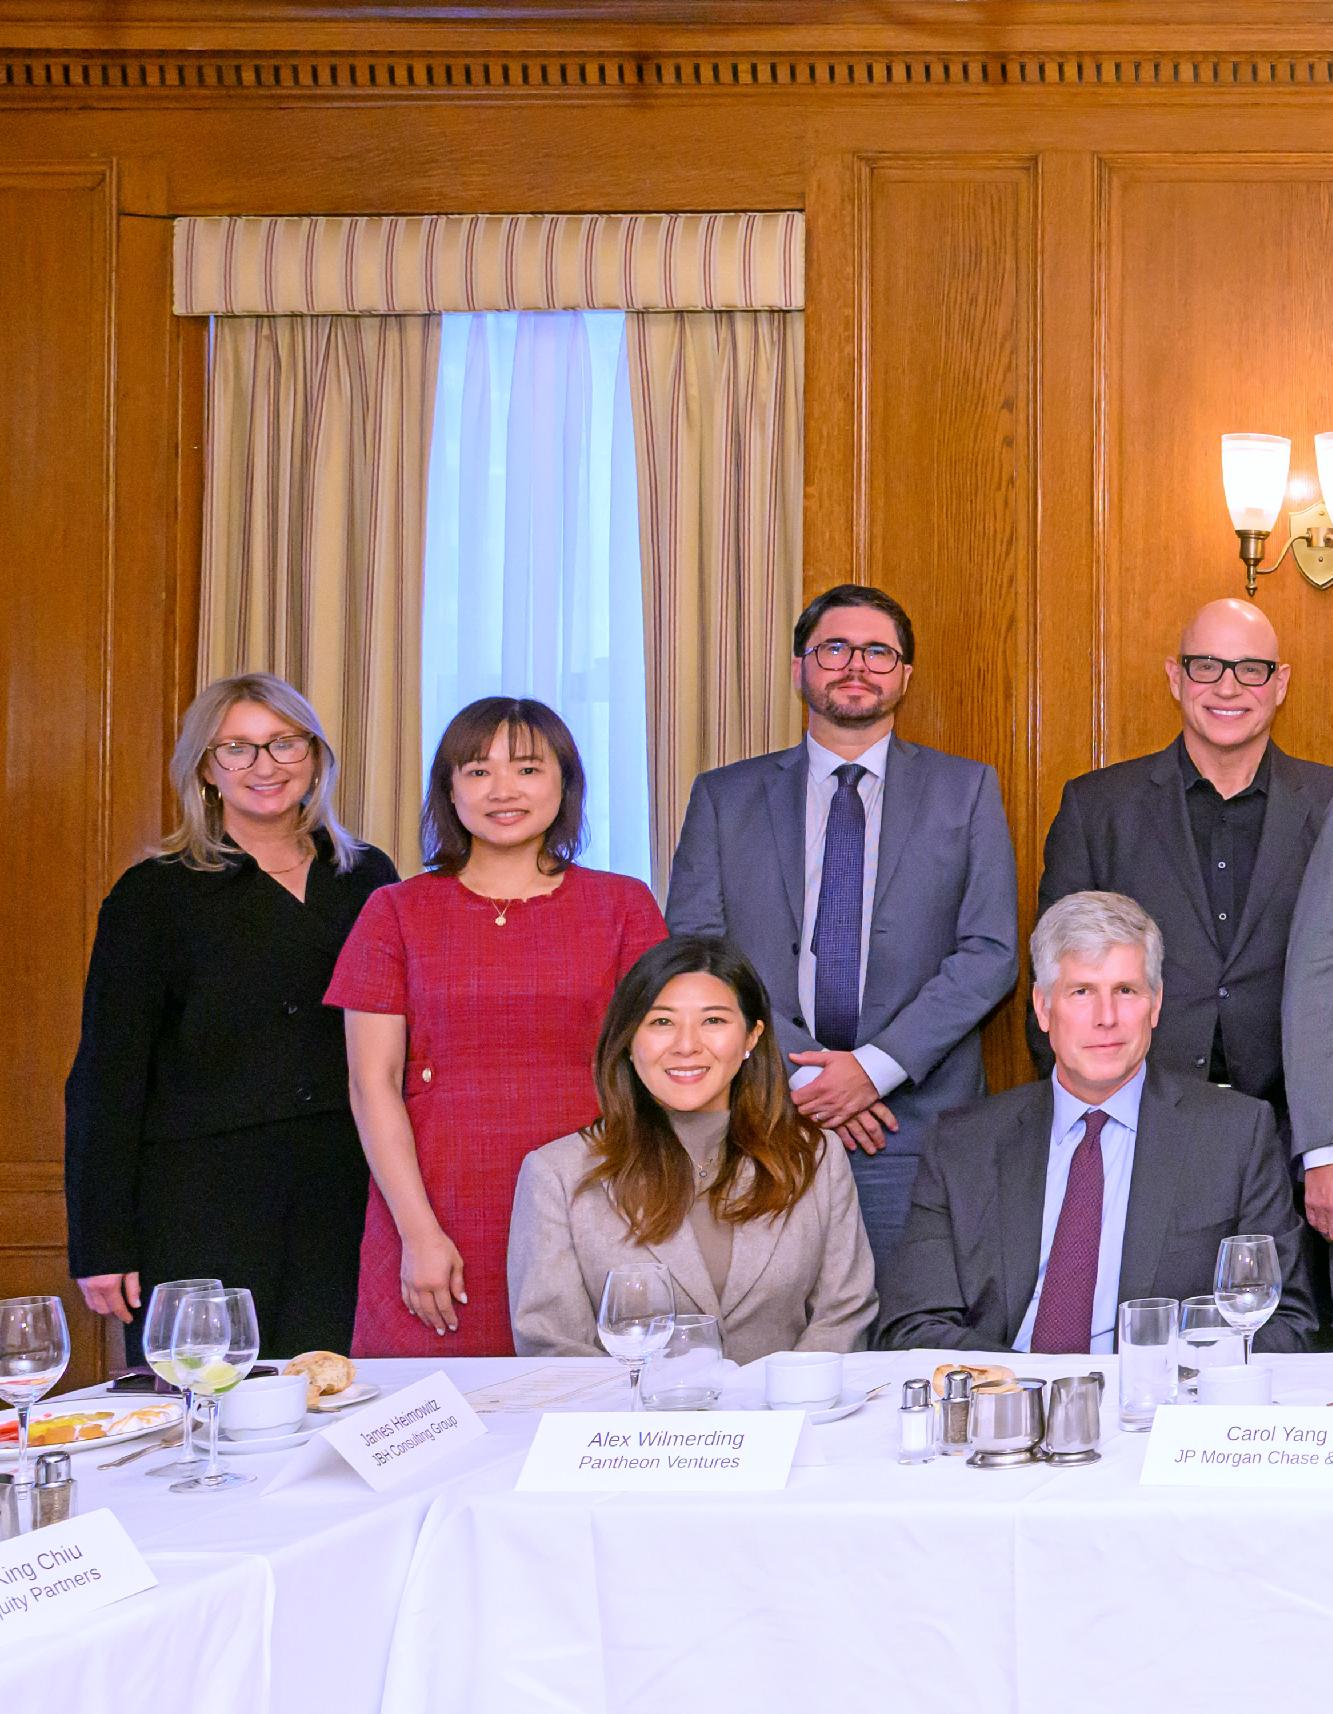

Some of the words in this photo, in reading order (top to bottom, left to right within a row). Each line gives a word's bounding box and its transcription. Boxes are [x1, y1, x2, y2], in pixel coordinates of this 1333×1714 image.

[360, 1423, 395, 1447] James
[390, 1400, 441, 1431] Heimowitz
[1226, 1426, 1276, 1442] Carol
[1283, 1426, 1328, 1446] Yang
[371, 1448, 394, 1467] JBH
[389, 1428, 436, 1456] Consulting
[430, 1415, 458, 1434] Group
[588, 1431, 632, 1447] Alex
[638, 1430, 745, 1450] Wilmerding
[578, 1455, 661, 1470] Pantheon
[667, 1455, 741, 1470] Ventures
[1174, 1449, 1197, 1464] JP
[1200, 1450, 1262, 1468] Morgan
[1267, 1450, 1319, 1465] Chase
[0, 1562, 37, 1585] ing
[37, 1544, 83, 1570] Chiu
[0, 1594, 29, 1621] uity
[30, 1567, 102, 1602] Partners
